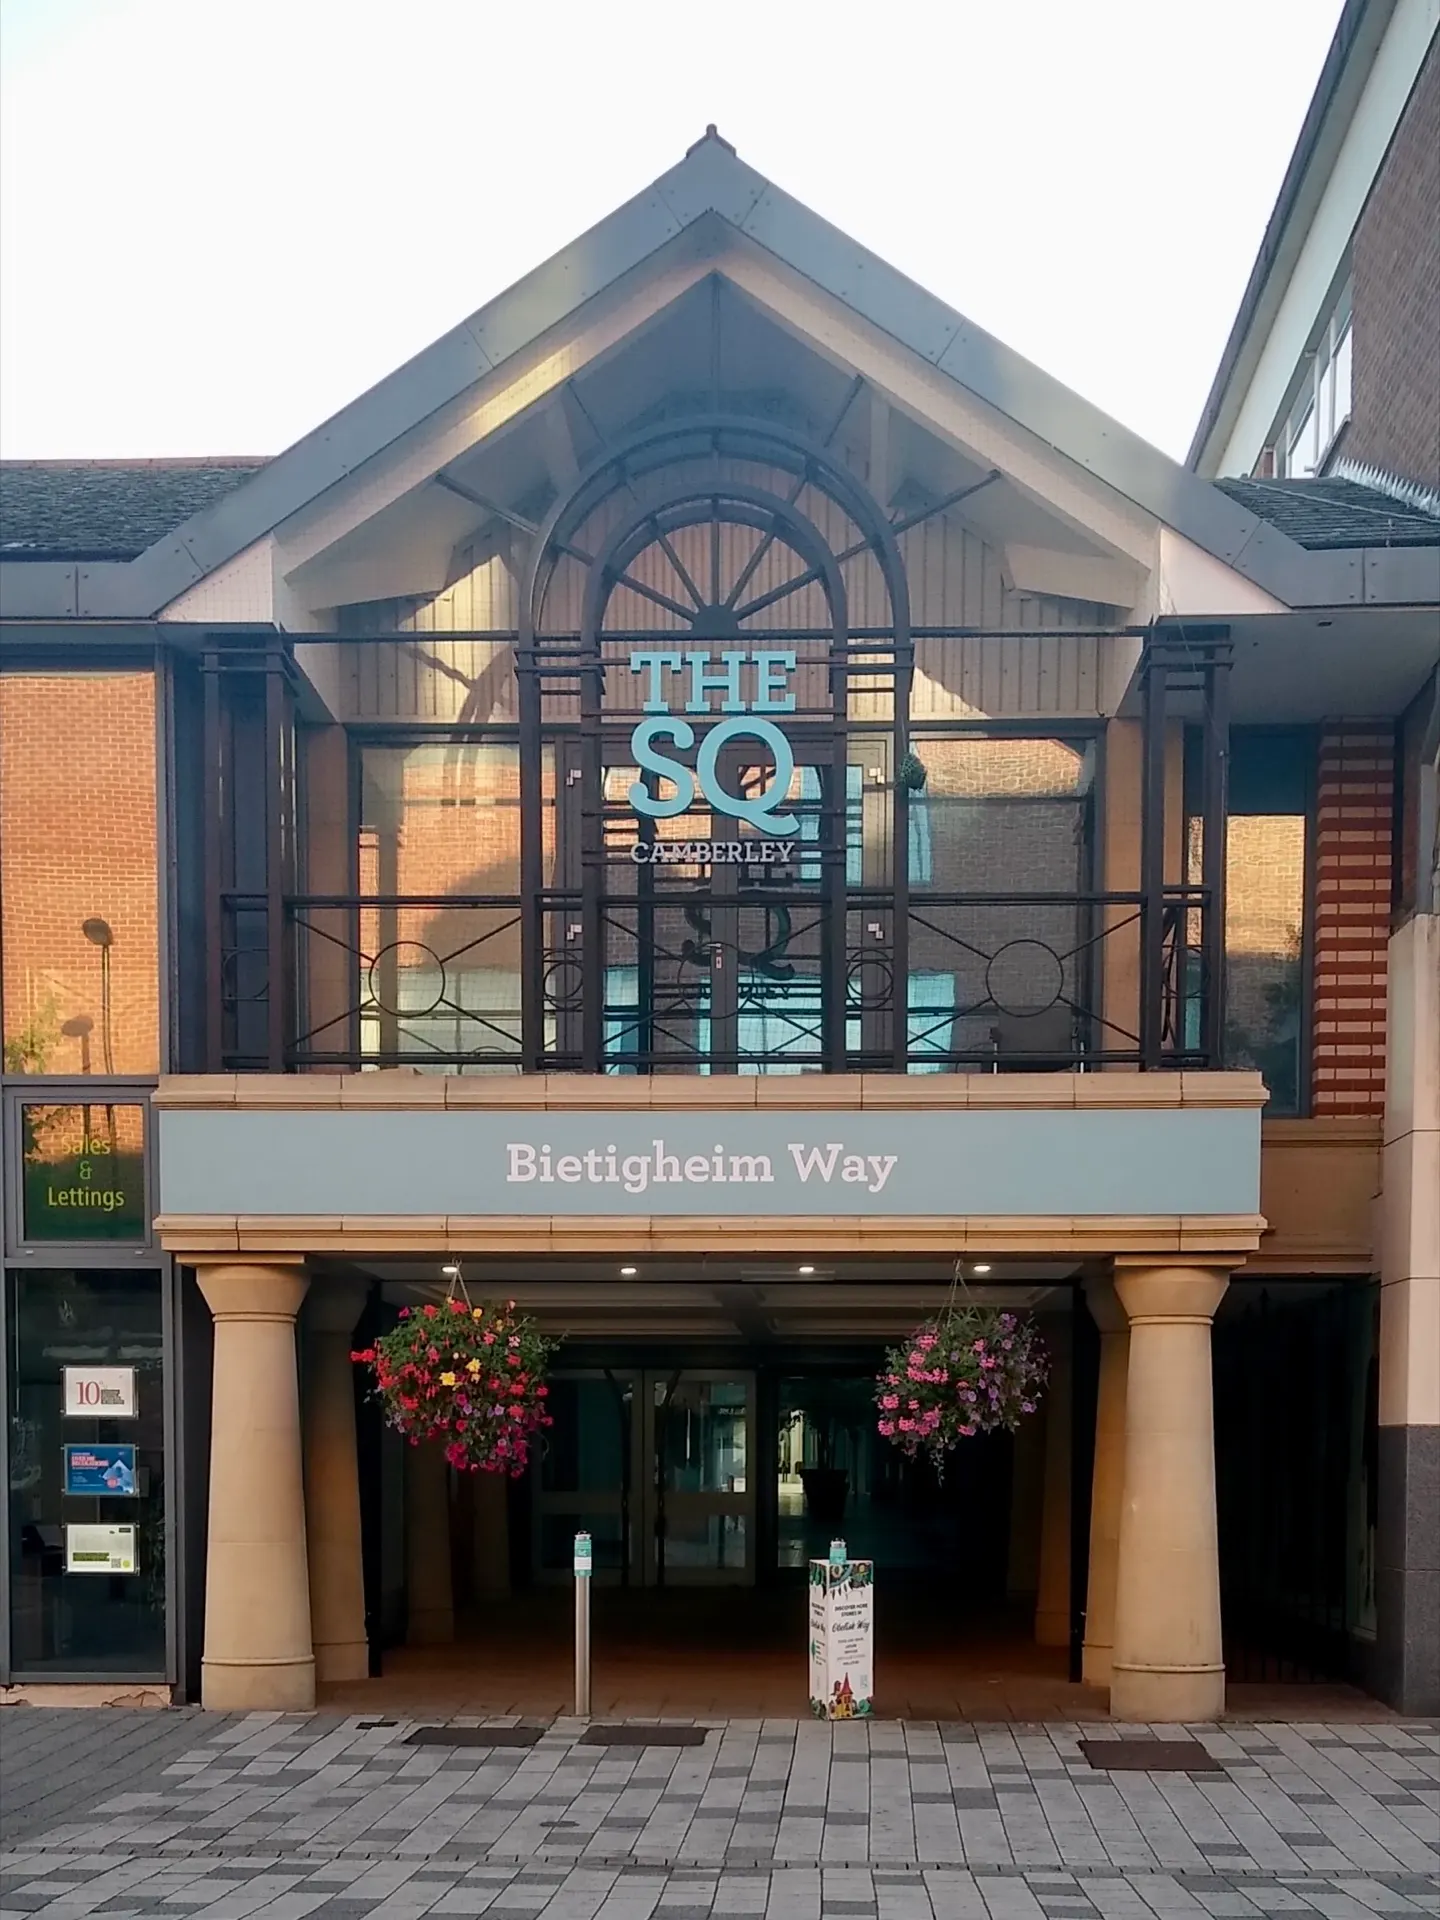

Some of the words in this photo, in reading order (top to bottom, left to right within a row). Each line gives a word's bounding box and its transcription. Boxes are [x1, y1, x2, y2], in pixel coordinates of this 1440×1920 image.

[630, 650, 797, 713] THE
[628, 716, 801, 837] SQ
[631, 841, 796, 864] CAMBERLEY
[61, 1134, 111, 1155] Sales
[79, 1160, 93, 1180] &
[506, 1140, 775, 1194] Bietigheim
[787, 1143, 898, 1193] Way
[48, 1186, 125, 1212] Lettings
